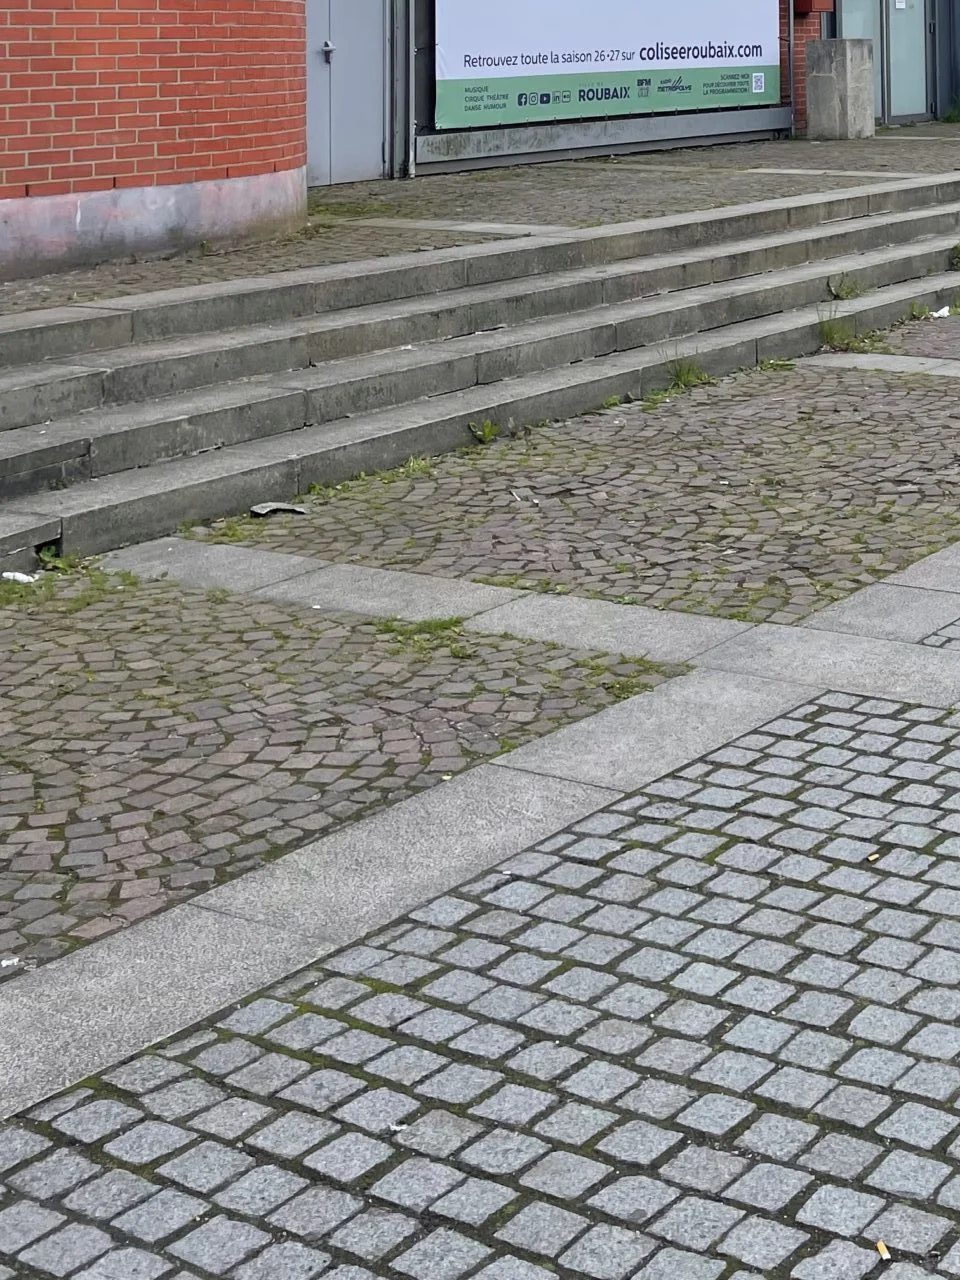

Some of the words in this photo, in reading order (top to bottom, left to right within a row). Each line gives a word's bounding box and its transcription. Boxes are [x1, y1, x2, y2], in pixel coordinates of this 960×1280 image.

[463, 54, 518, 68] Retrouvez
[520, 52, 549, 65] toute
[550, 52, 560, 64] la
[561, 51, 592, 63] saison
[621, 51, 636, 62] sur
[639, 41, 763, 61] coliseeroubaix.com
[578, 86, 630, 102] ROUBAIX
